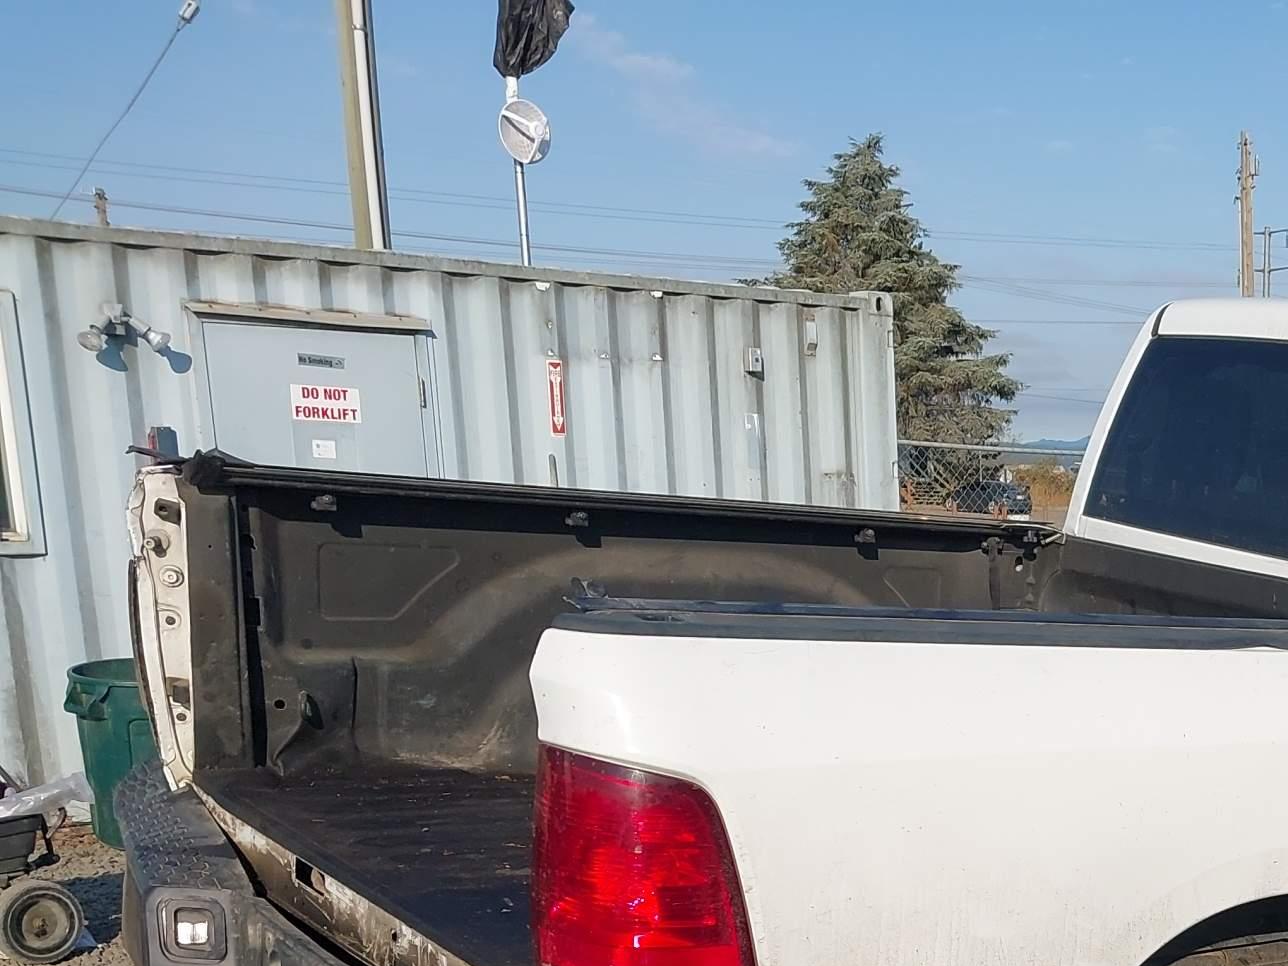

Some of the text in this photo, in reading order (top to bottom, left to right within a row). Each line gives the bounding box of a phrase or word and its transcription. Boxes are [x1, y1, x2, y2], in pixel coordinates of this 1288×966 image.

[301, 386, 348, 401] DO NOT
[295, 405, 358, 421] FORKLIFT
